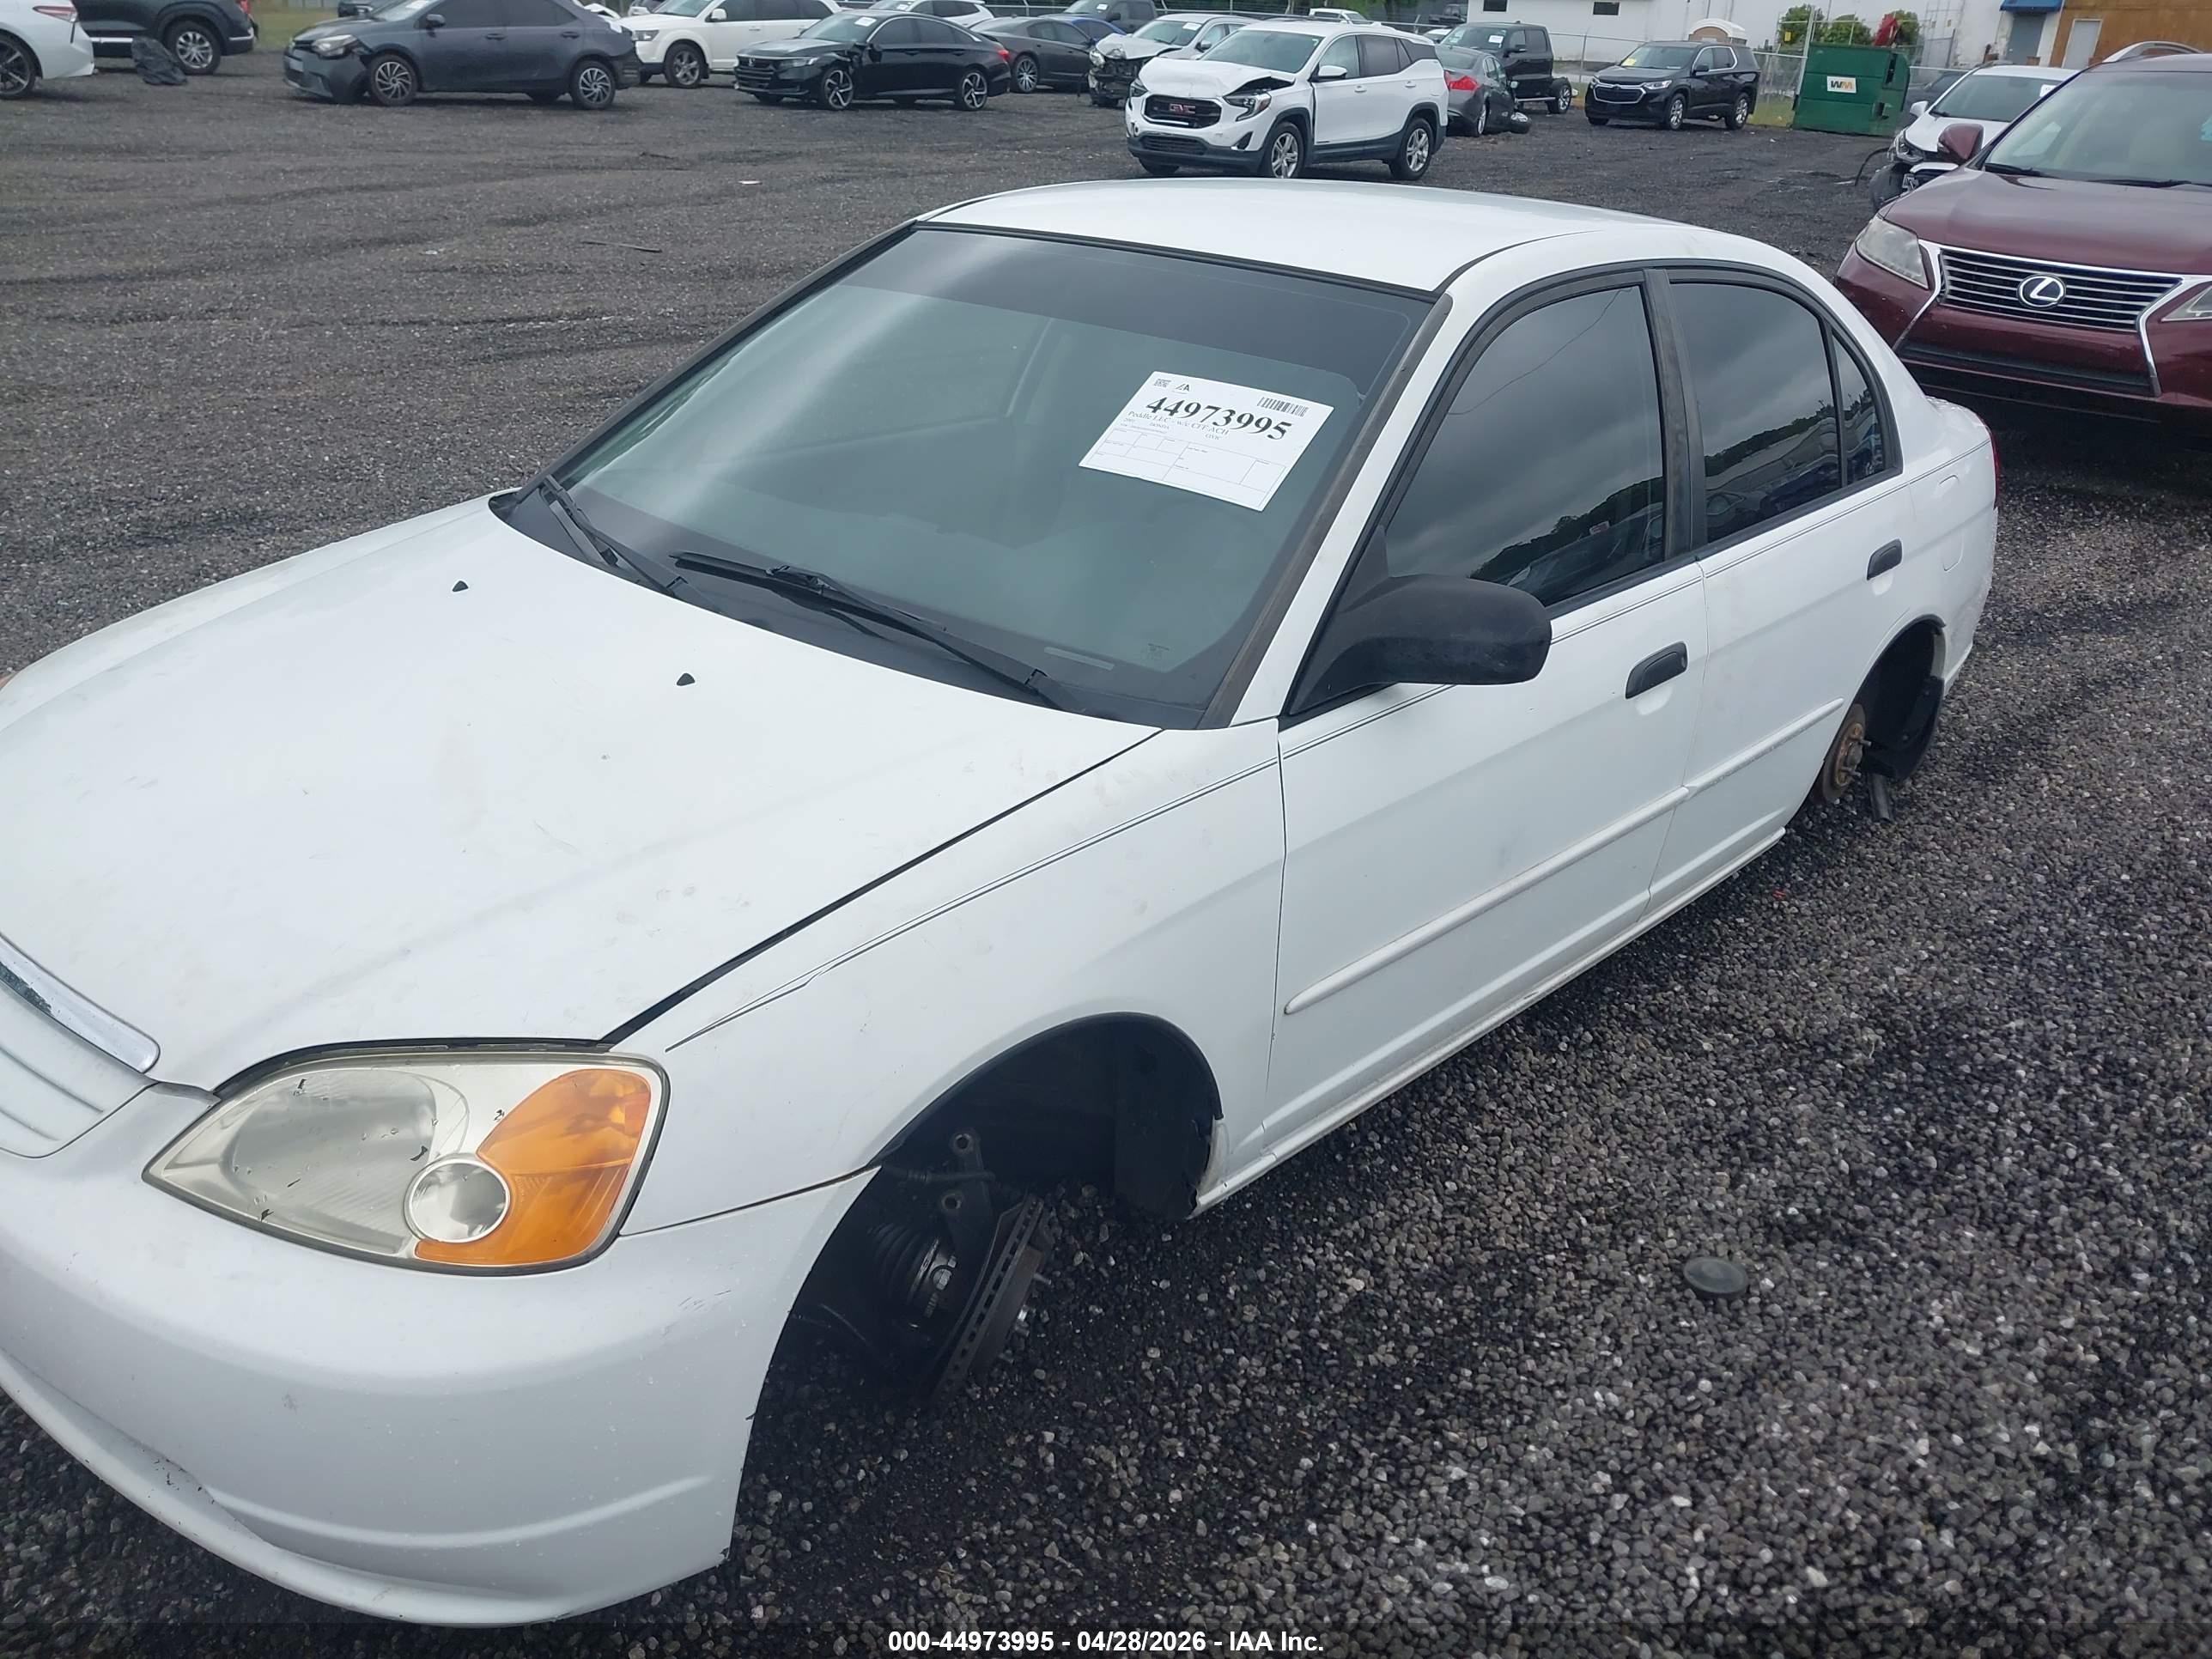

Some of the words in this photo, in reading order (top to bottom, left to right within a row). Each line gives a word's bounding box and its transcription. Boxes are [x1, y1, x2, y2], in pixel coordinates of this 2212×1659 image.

[1830, 80, 1853, 90] WM
[1169, 103, 1196, 114] GMC
[1146, 396, 1291, 441] 44973995
